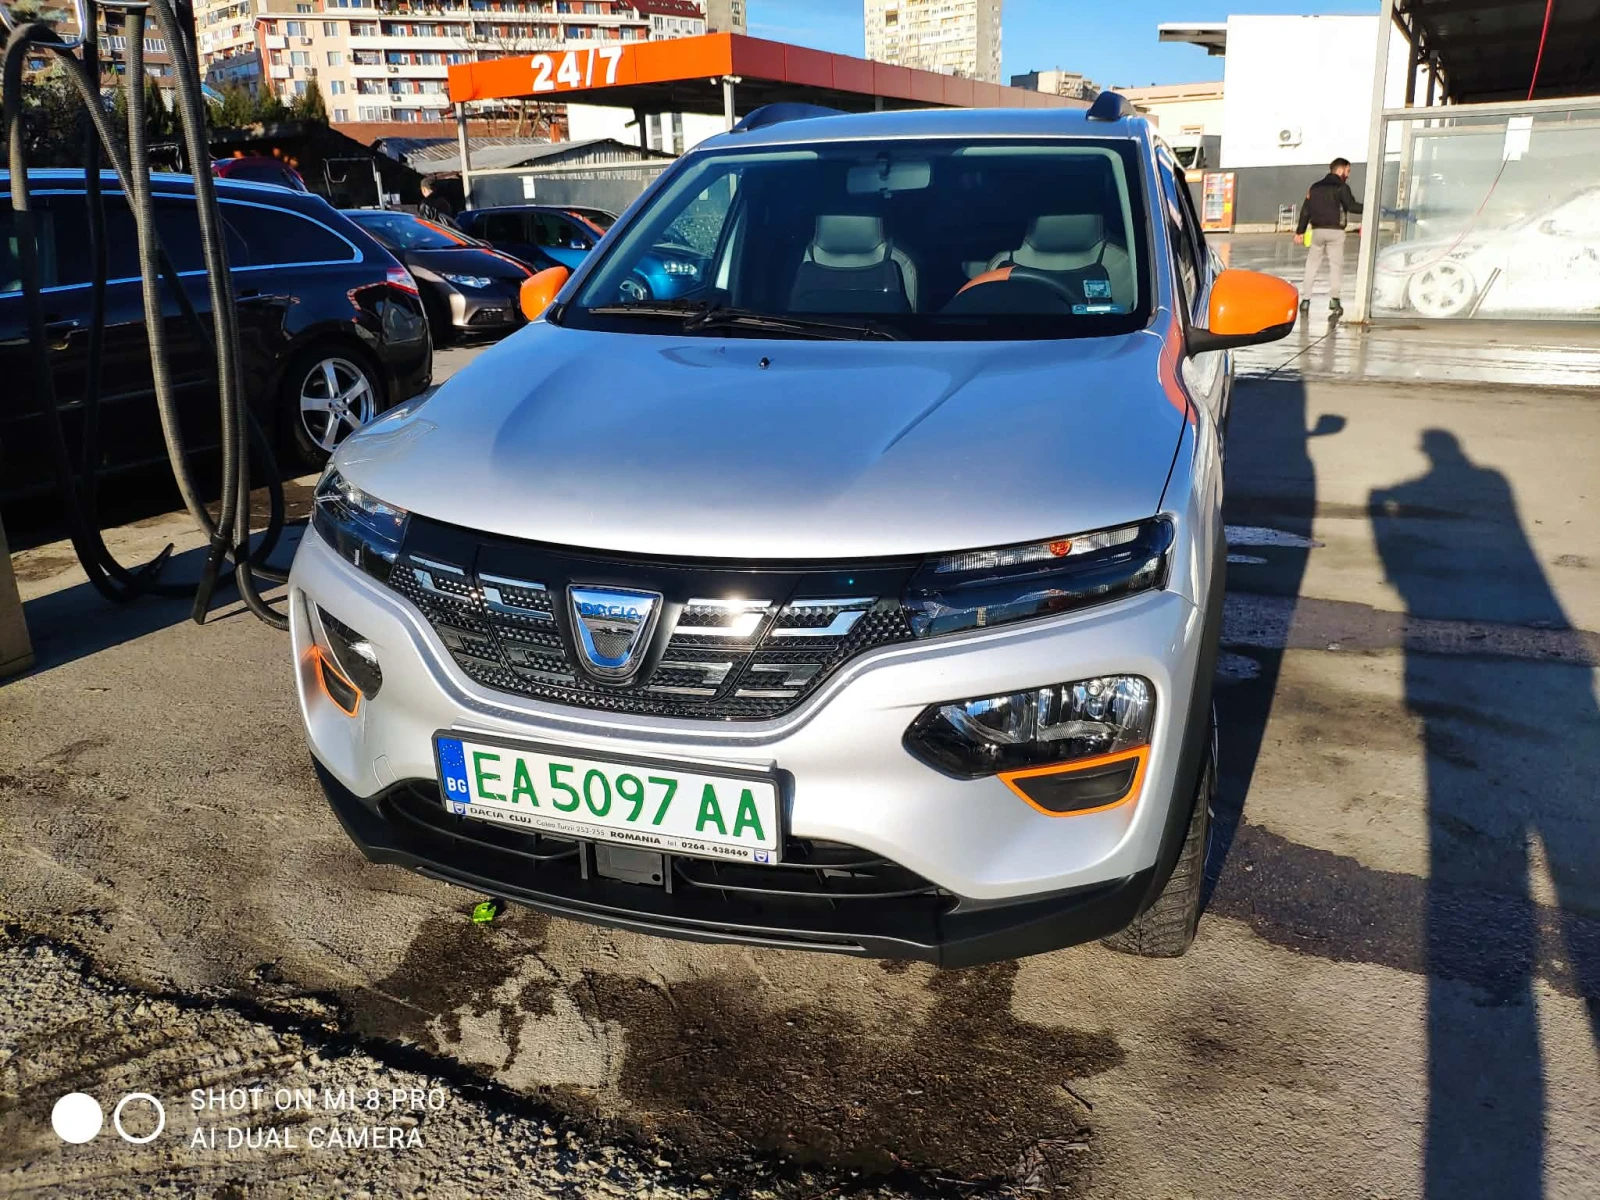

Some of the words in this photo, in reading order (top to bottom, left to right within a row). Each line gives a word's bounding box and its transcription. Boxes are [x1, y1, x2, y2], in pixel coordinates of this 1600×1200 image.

[531, 47, 623, 91] 24/7
[580, 602, 642, 619] DACIA
[446, 776, 468, 793] BG
[469, 806, 505, 820] DACIA
[509, 813, 532, 824] CLUJ
[610, 830, 661, 845] ROMANIA
[695, 784, 766, 841] AA
